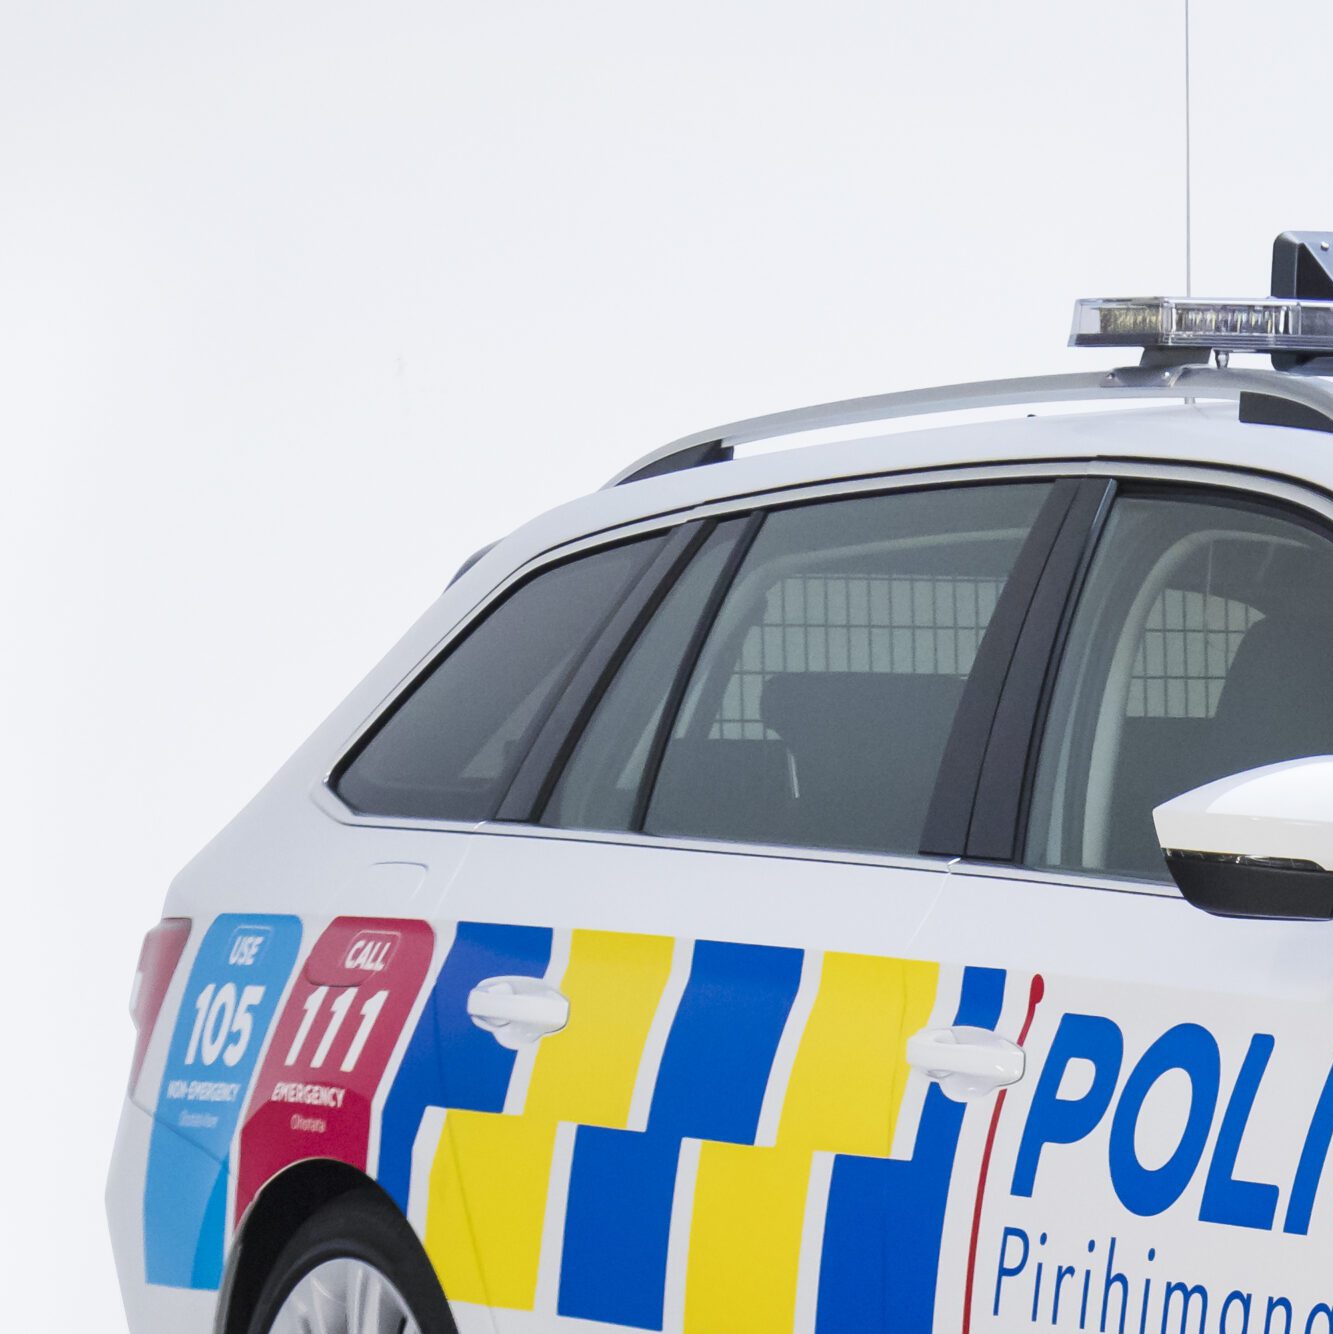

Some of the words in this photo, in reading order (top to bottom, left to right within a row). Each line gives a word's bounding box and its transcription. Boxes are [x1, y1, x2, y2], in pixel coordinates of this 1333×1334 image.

[229, 936, 264, 966] USE
[344, 939, 391, 971] CALL
[184, 982, 266, 1067] 105
[284, 985, 390, 1073] 111
[271, 1082, 345, 1108] EMERGENCY
